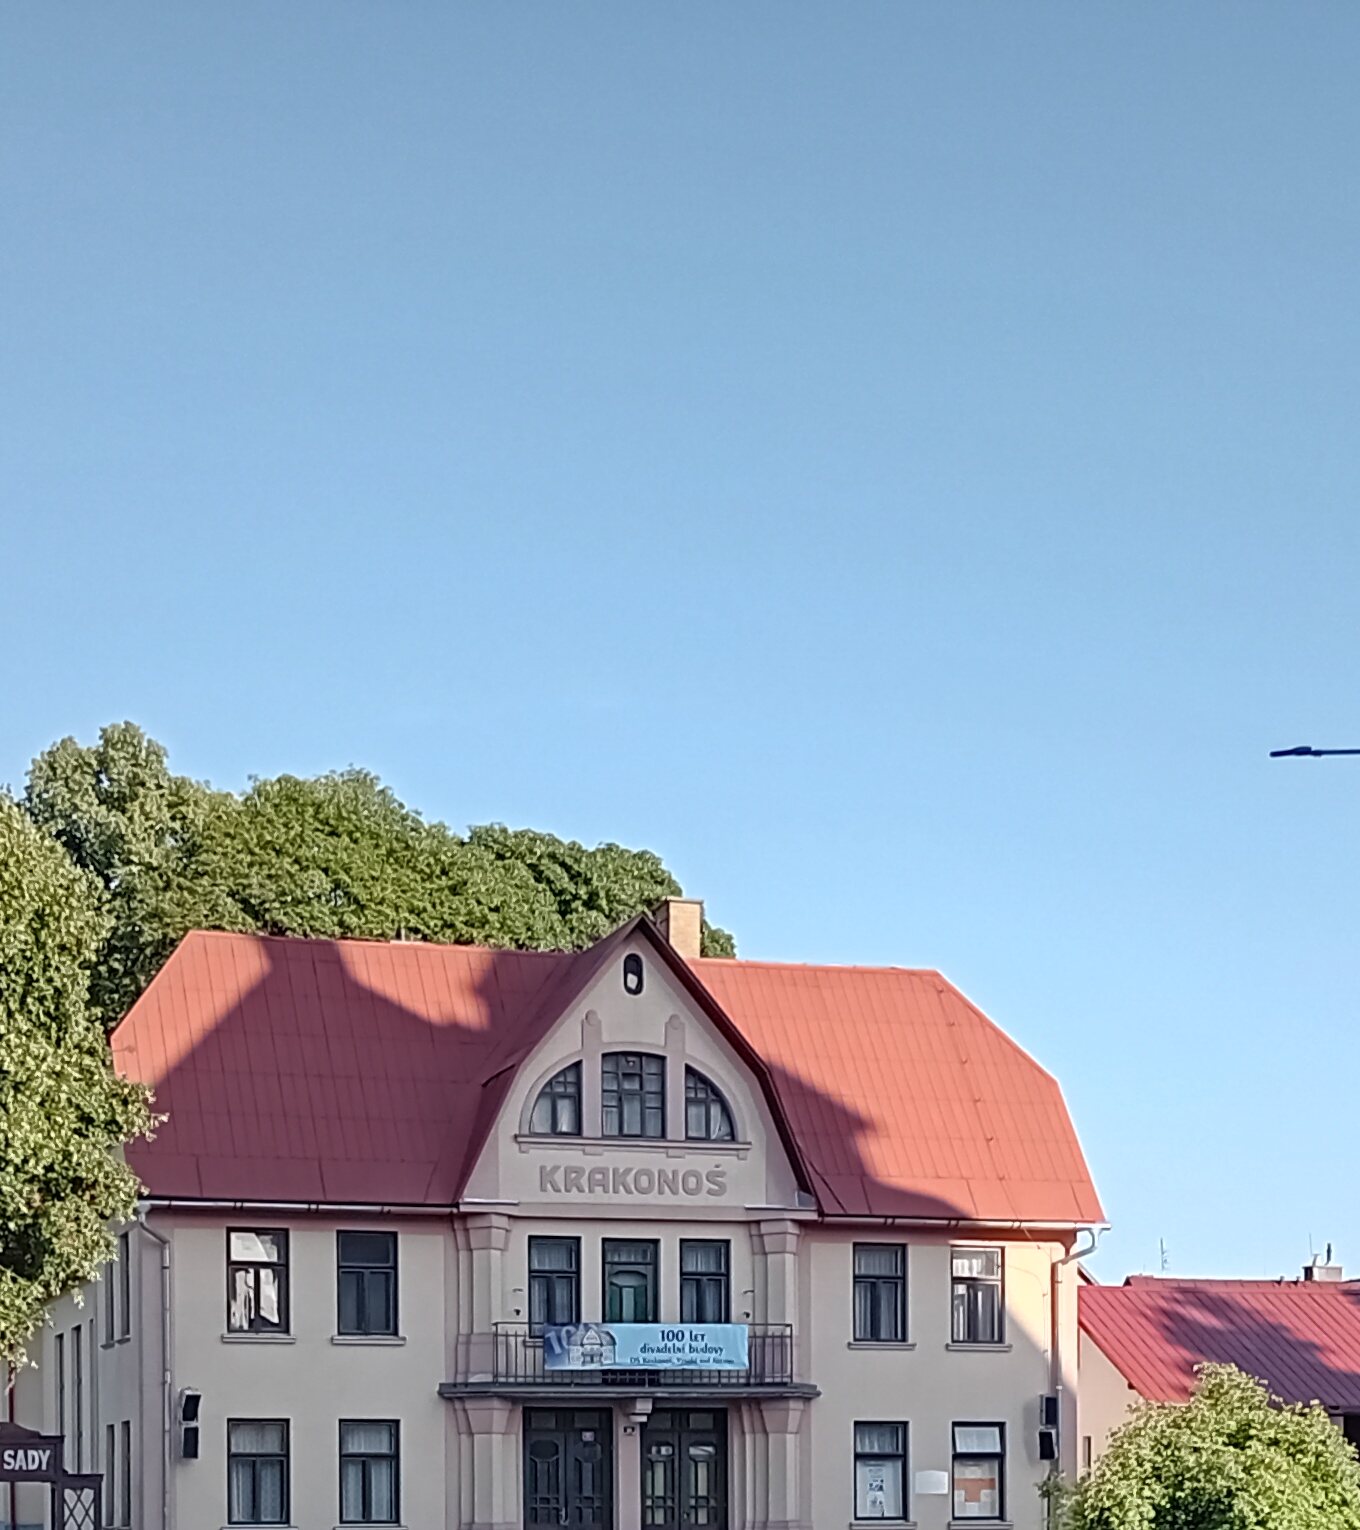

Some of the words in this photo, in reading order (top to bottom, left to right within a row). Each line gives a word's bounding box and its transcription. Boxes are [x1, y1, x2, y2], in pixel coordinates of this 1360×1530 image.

[660, 1329, 685, 1343] 100
[689, 1342, 724, 1357] budovy
[3, 1449, 51, 1471] SADY
